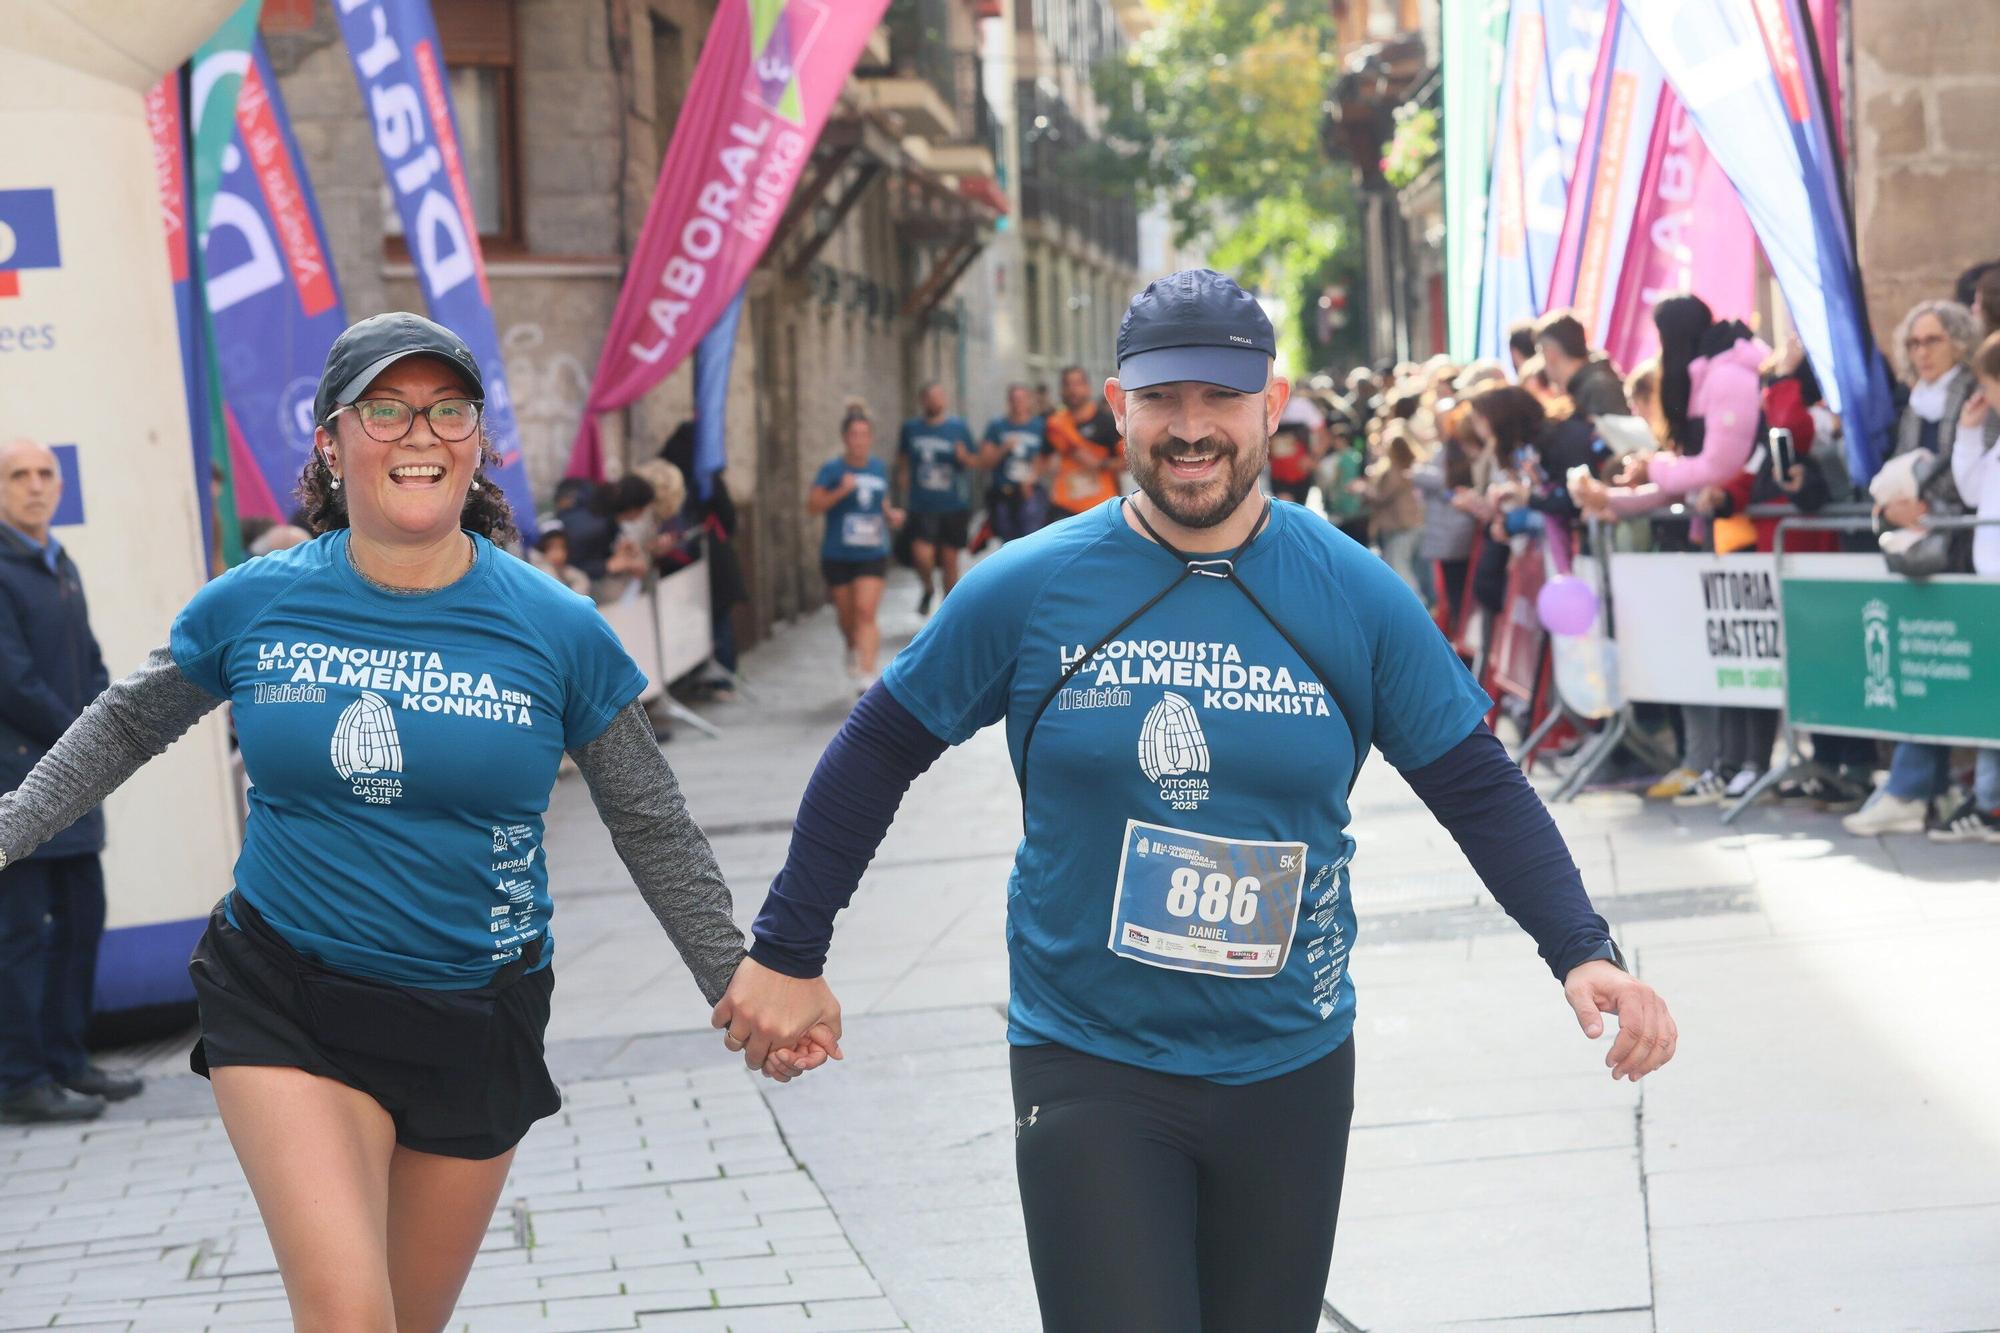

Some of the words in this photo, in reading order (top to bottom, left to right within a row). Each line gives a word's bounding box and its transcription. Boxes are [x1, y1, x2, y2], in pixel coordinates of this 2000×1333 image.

[629, 119, 773, 364] LABORAL
[1700, 571, 1777, 611] VITORIA
[1706, 618, 1781, 658] GASTEIZ
[259, 642, 286, 661] LA
[290, 643, 443, 671] CONQUISTA
[1060, 644, 1086, 664] LA
[1092, 639, 1242, 664] CONQUISTA
[257, 660, 275, 672] DE
[278, 659, 295, 671] LA
[290, 659, 499, 701] ALMENDRA
[502, 689, 532, 708] REN
[1082, 660, 1098, 673] LA
[1095, 659, 1297, 694] ALMENDRA
[1298, 681, 1325, 696] REN
[254, 682, 266, 704] II
[266, 682, 326, 704] Edición
[1058, 688, 1072, 711] II
[1072, 686, 1132, 709] Edición
[1203, 689, 1331, 717] KONKISTA
[402, 692, 533, 727] KONKISTA
[351, 776, 402, 788] VITORIA
[352, 785, 403, 798] GASTEIZ
[1159, 778, 1209, 789] VITORIA
[365, 796, 391, 805] 2025
[1160, 789, 1209, 801] GASTEIZ
[1171, 801, 1198, 810] 2025
[492, 858, 528, 872] LABORAL
[1280, 855, 1296, 868] 5K
[1166, 867, 1261, 925] 886
[1188, 924, 1229, 941] DANIEL
